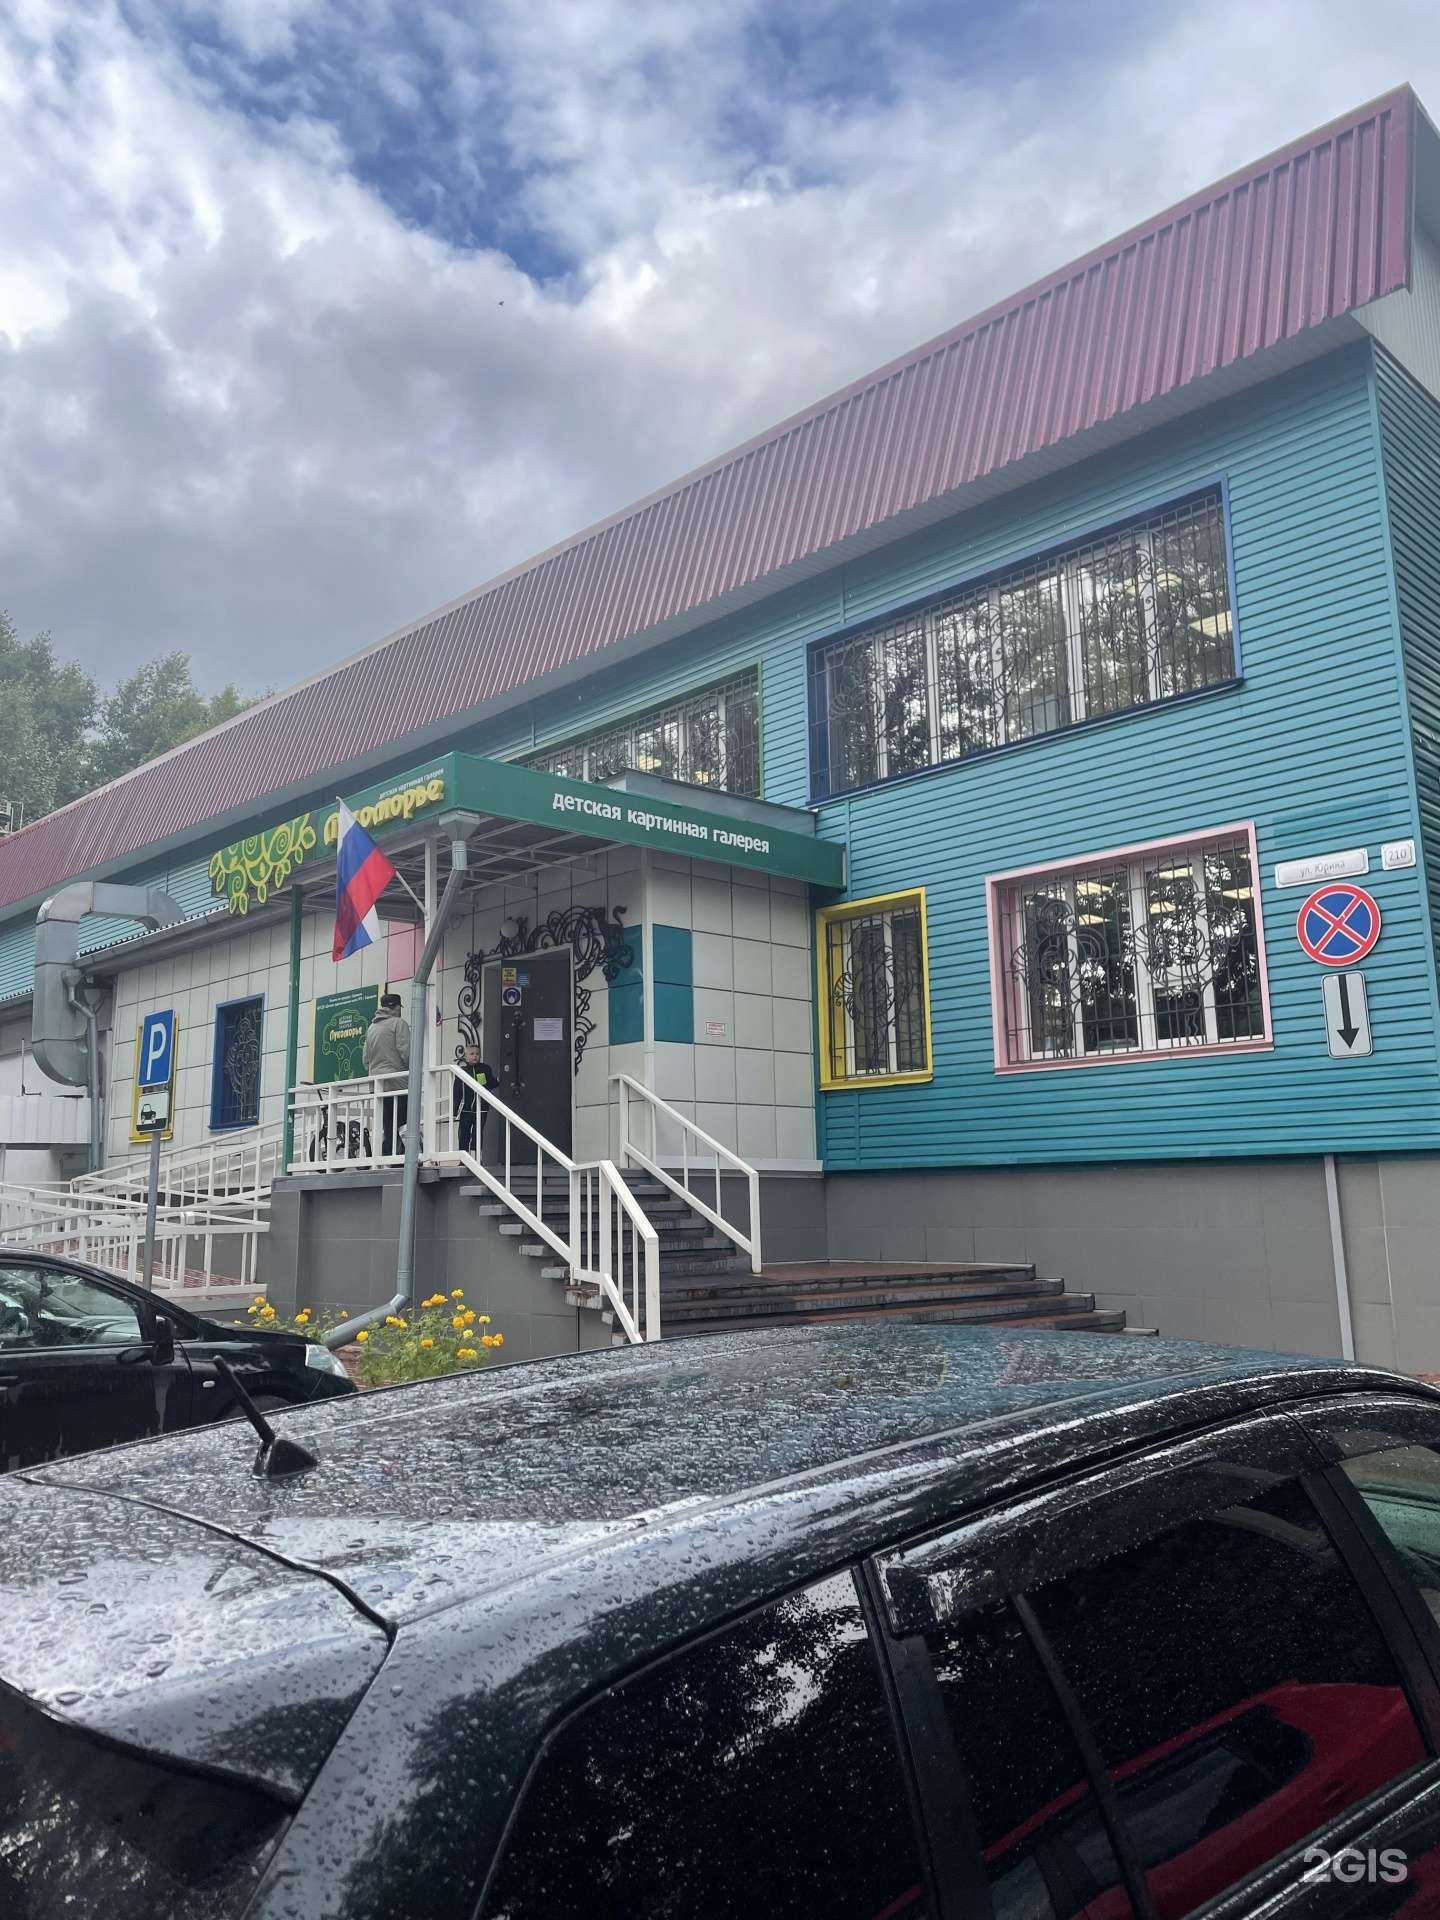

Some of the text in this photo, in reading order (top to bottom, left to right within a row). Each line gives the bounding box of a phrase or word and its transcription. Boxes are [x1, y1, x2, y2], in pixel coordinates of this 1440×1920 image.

[552, 792, 770, 854] детская картинная галерея
[1388, 848, 1407, 862] 210
[146, 1021, 167, 1081] P
